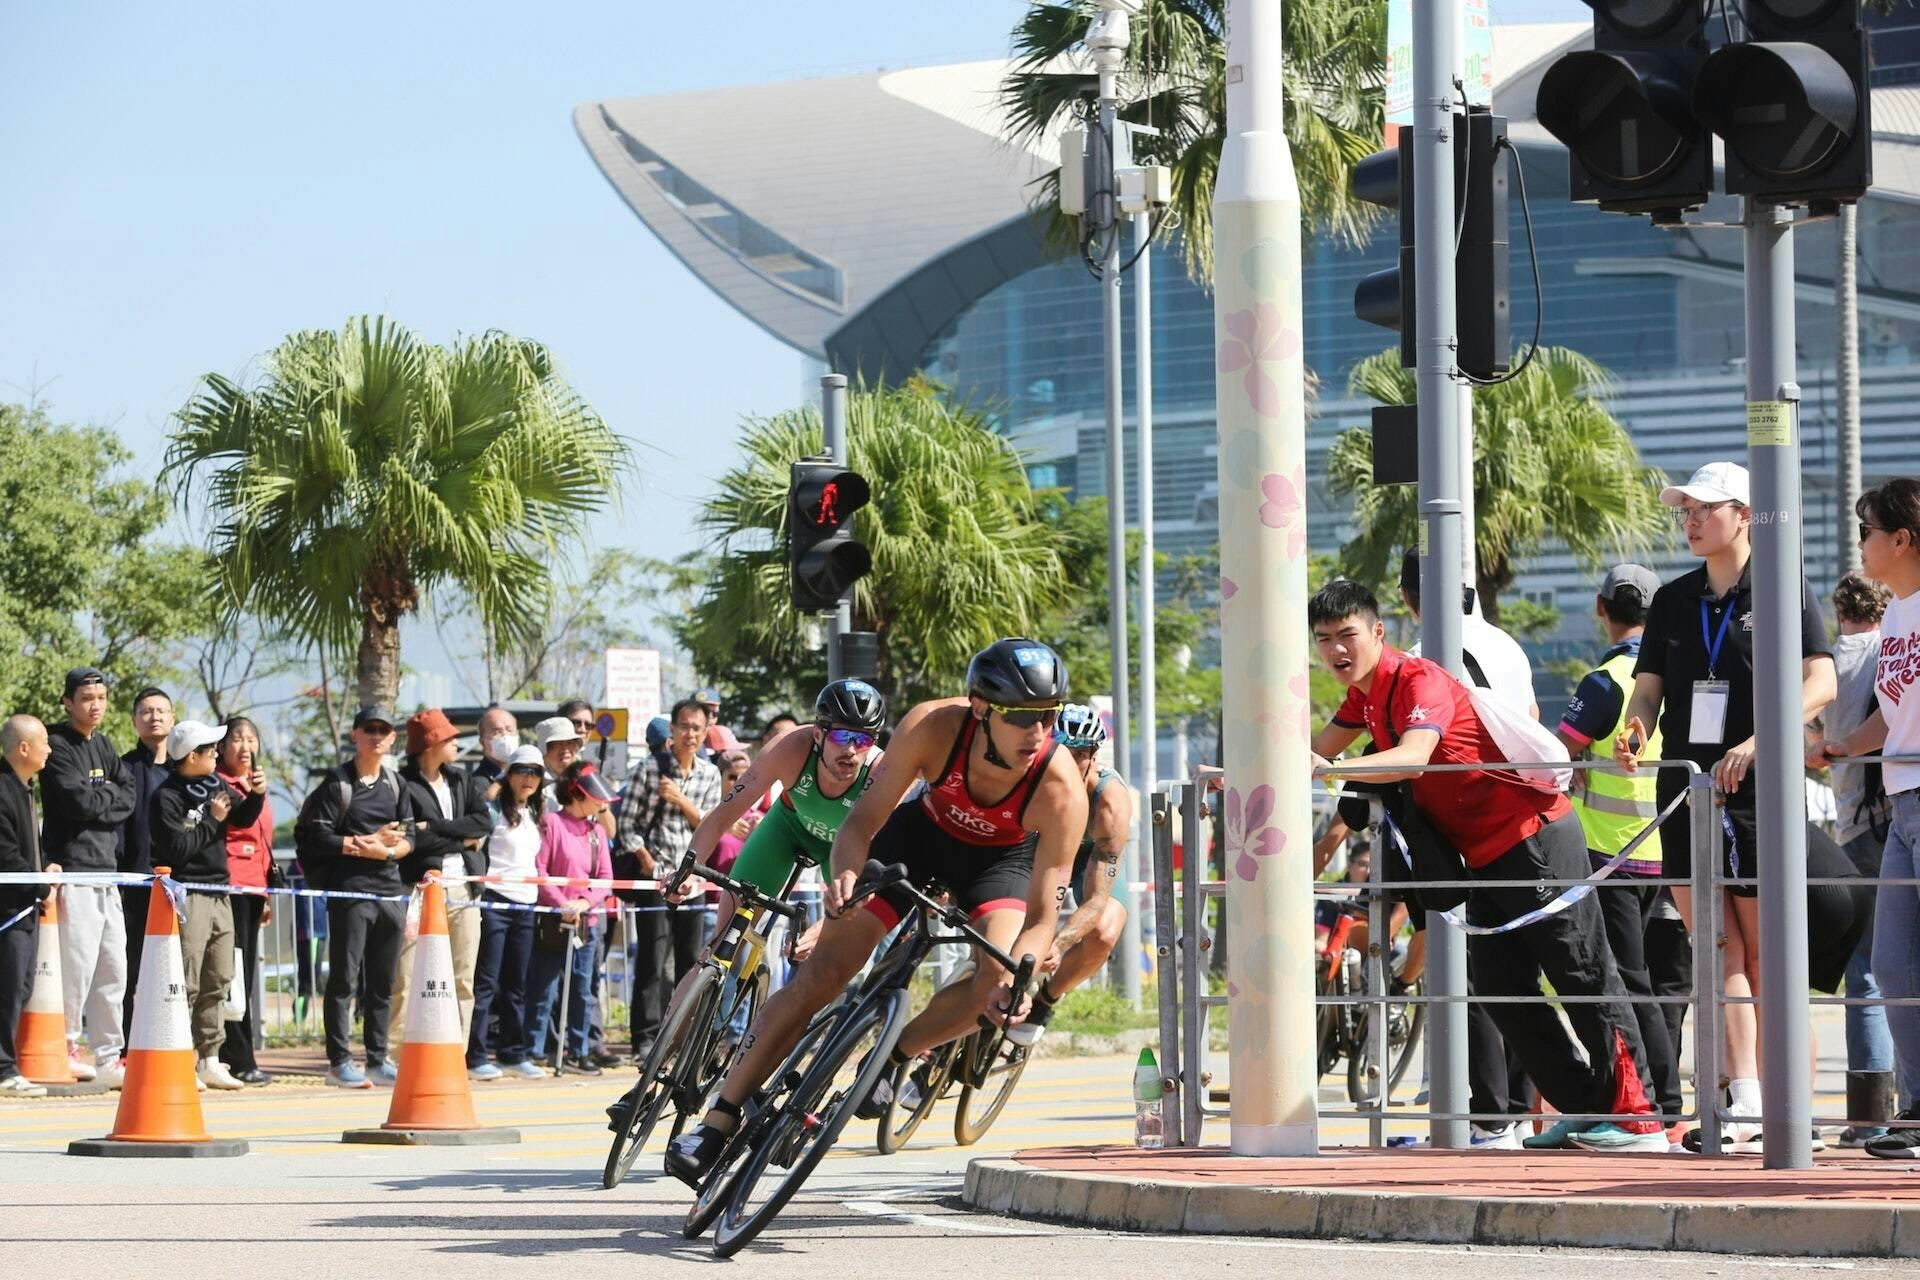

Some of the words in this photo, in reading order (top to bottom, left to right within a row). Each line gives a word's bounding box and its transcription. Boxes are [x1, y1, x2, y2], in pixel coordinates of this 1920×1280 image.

[1019, 649, 1041, 662] 31
[1107, 855, 1118, 878] 38
[735, 1034, 756, 1066] 31
